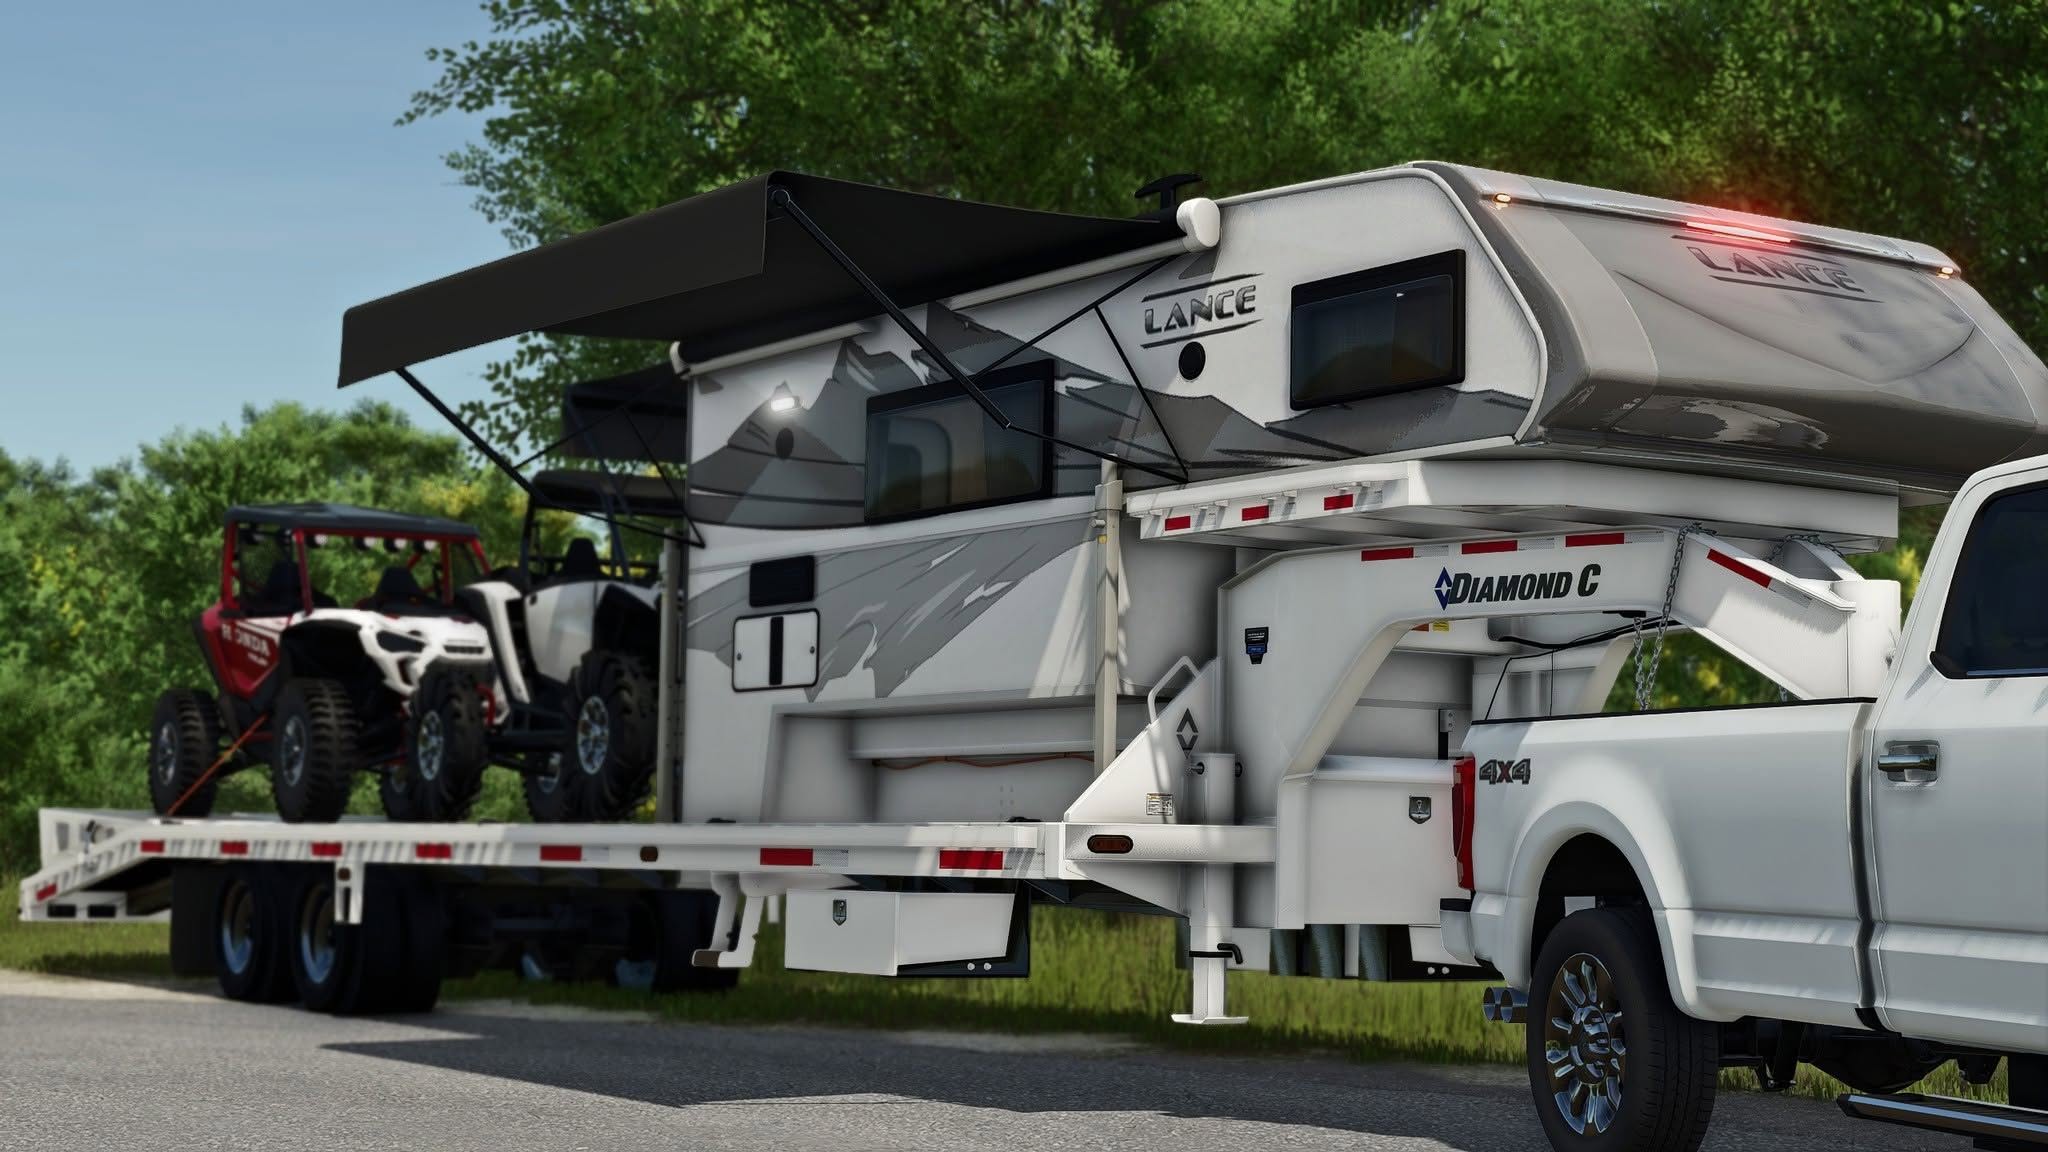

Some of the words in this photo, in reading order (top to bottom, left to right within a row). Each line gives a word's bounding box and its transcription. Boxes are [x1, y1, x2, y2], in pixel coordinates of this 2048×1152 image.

[1687, 246, 1865, 293] LANCE
[1144, 284, 1256, 335] LANCE
[1577, 563, 1602, 597] C
